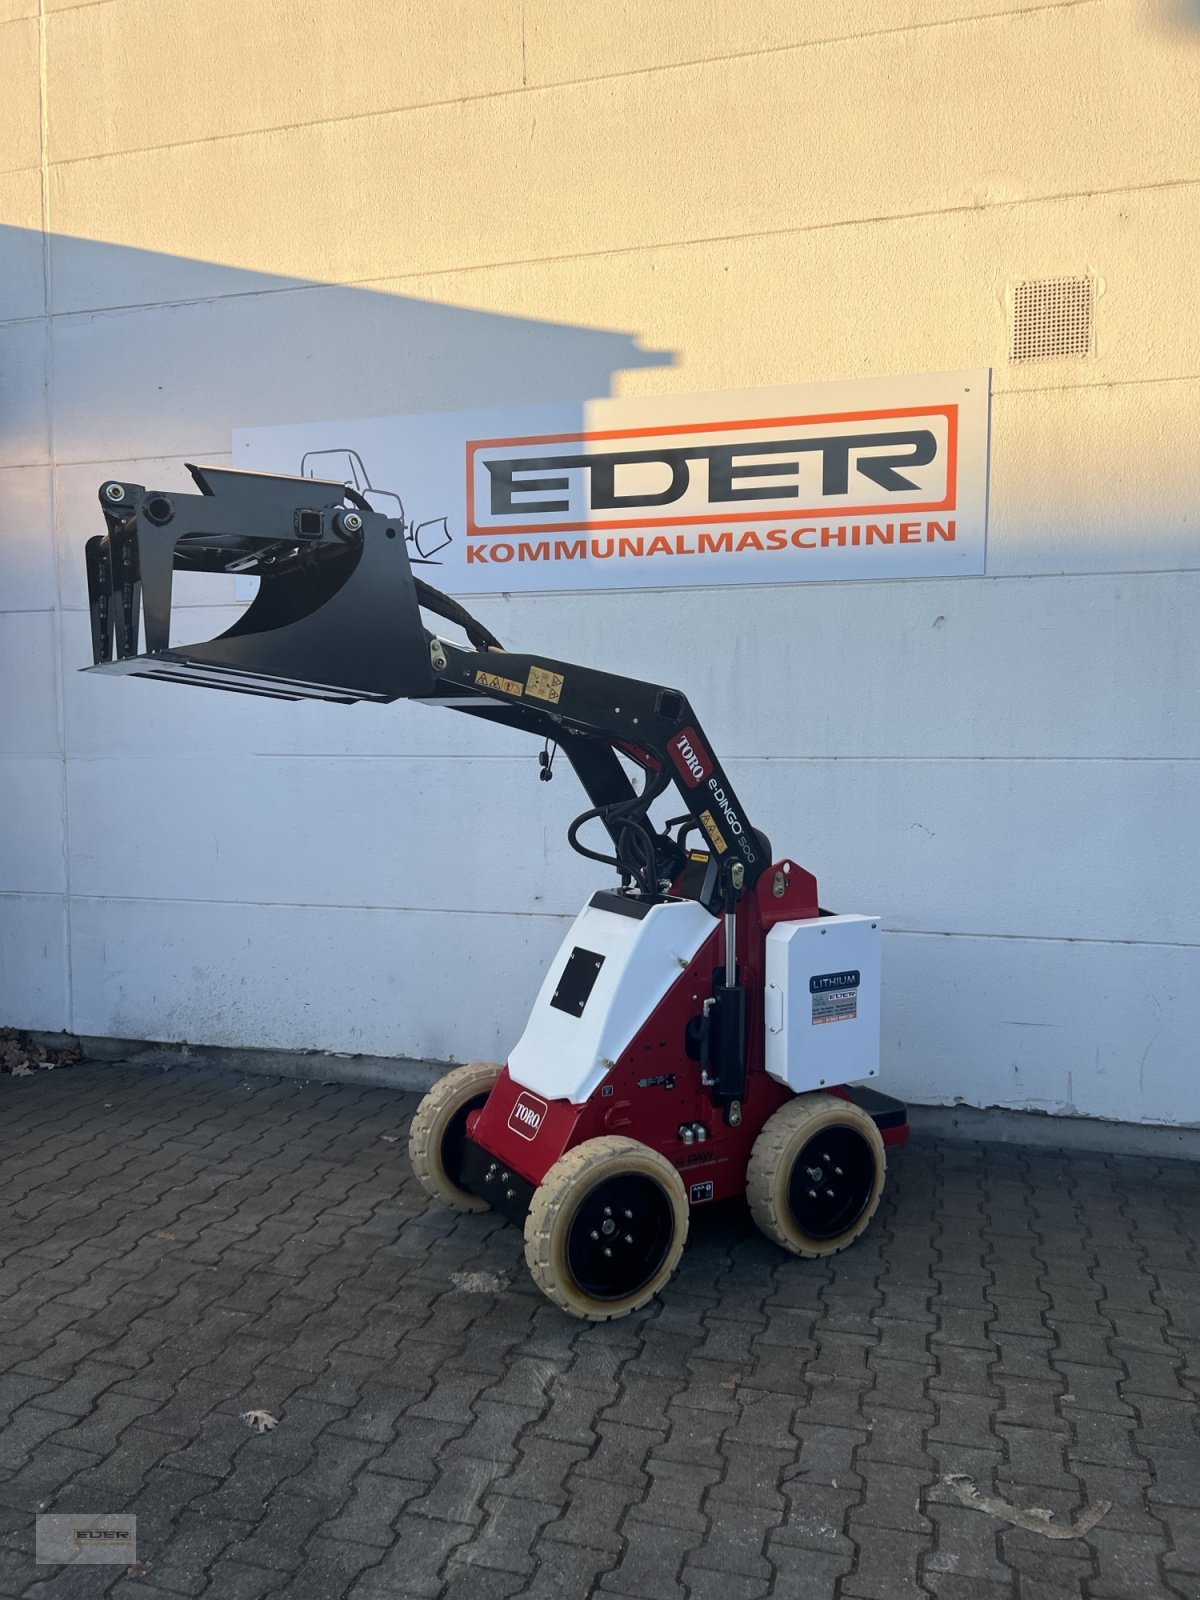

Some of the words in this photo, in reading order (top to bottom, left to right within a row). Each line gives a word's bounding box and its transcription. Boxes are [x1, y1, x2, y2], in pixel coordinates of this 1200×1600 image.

[482, 429, 937, 515] EDER
[466, 520, 957, 563] KOMMUNALMASCHINEN
[677, 735, 704, 779] TORO
[738, 836, 756, 863] 500
[813, 975, 857, 989] LITHIUM
[515, 1103, 540, 1128] TORO
